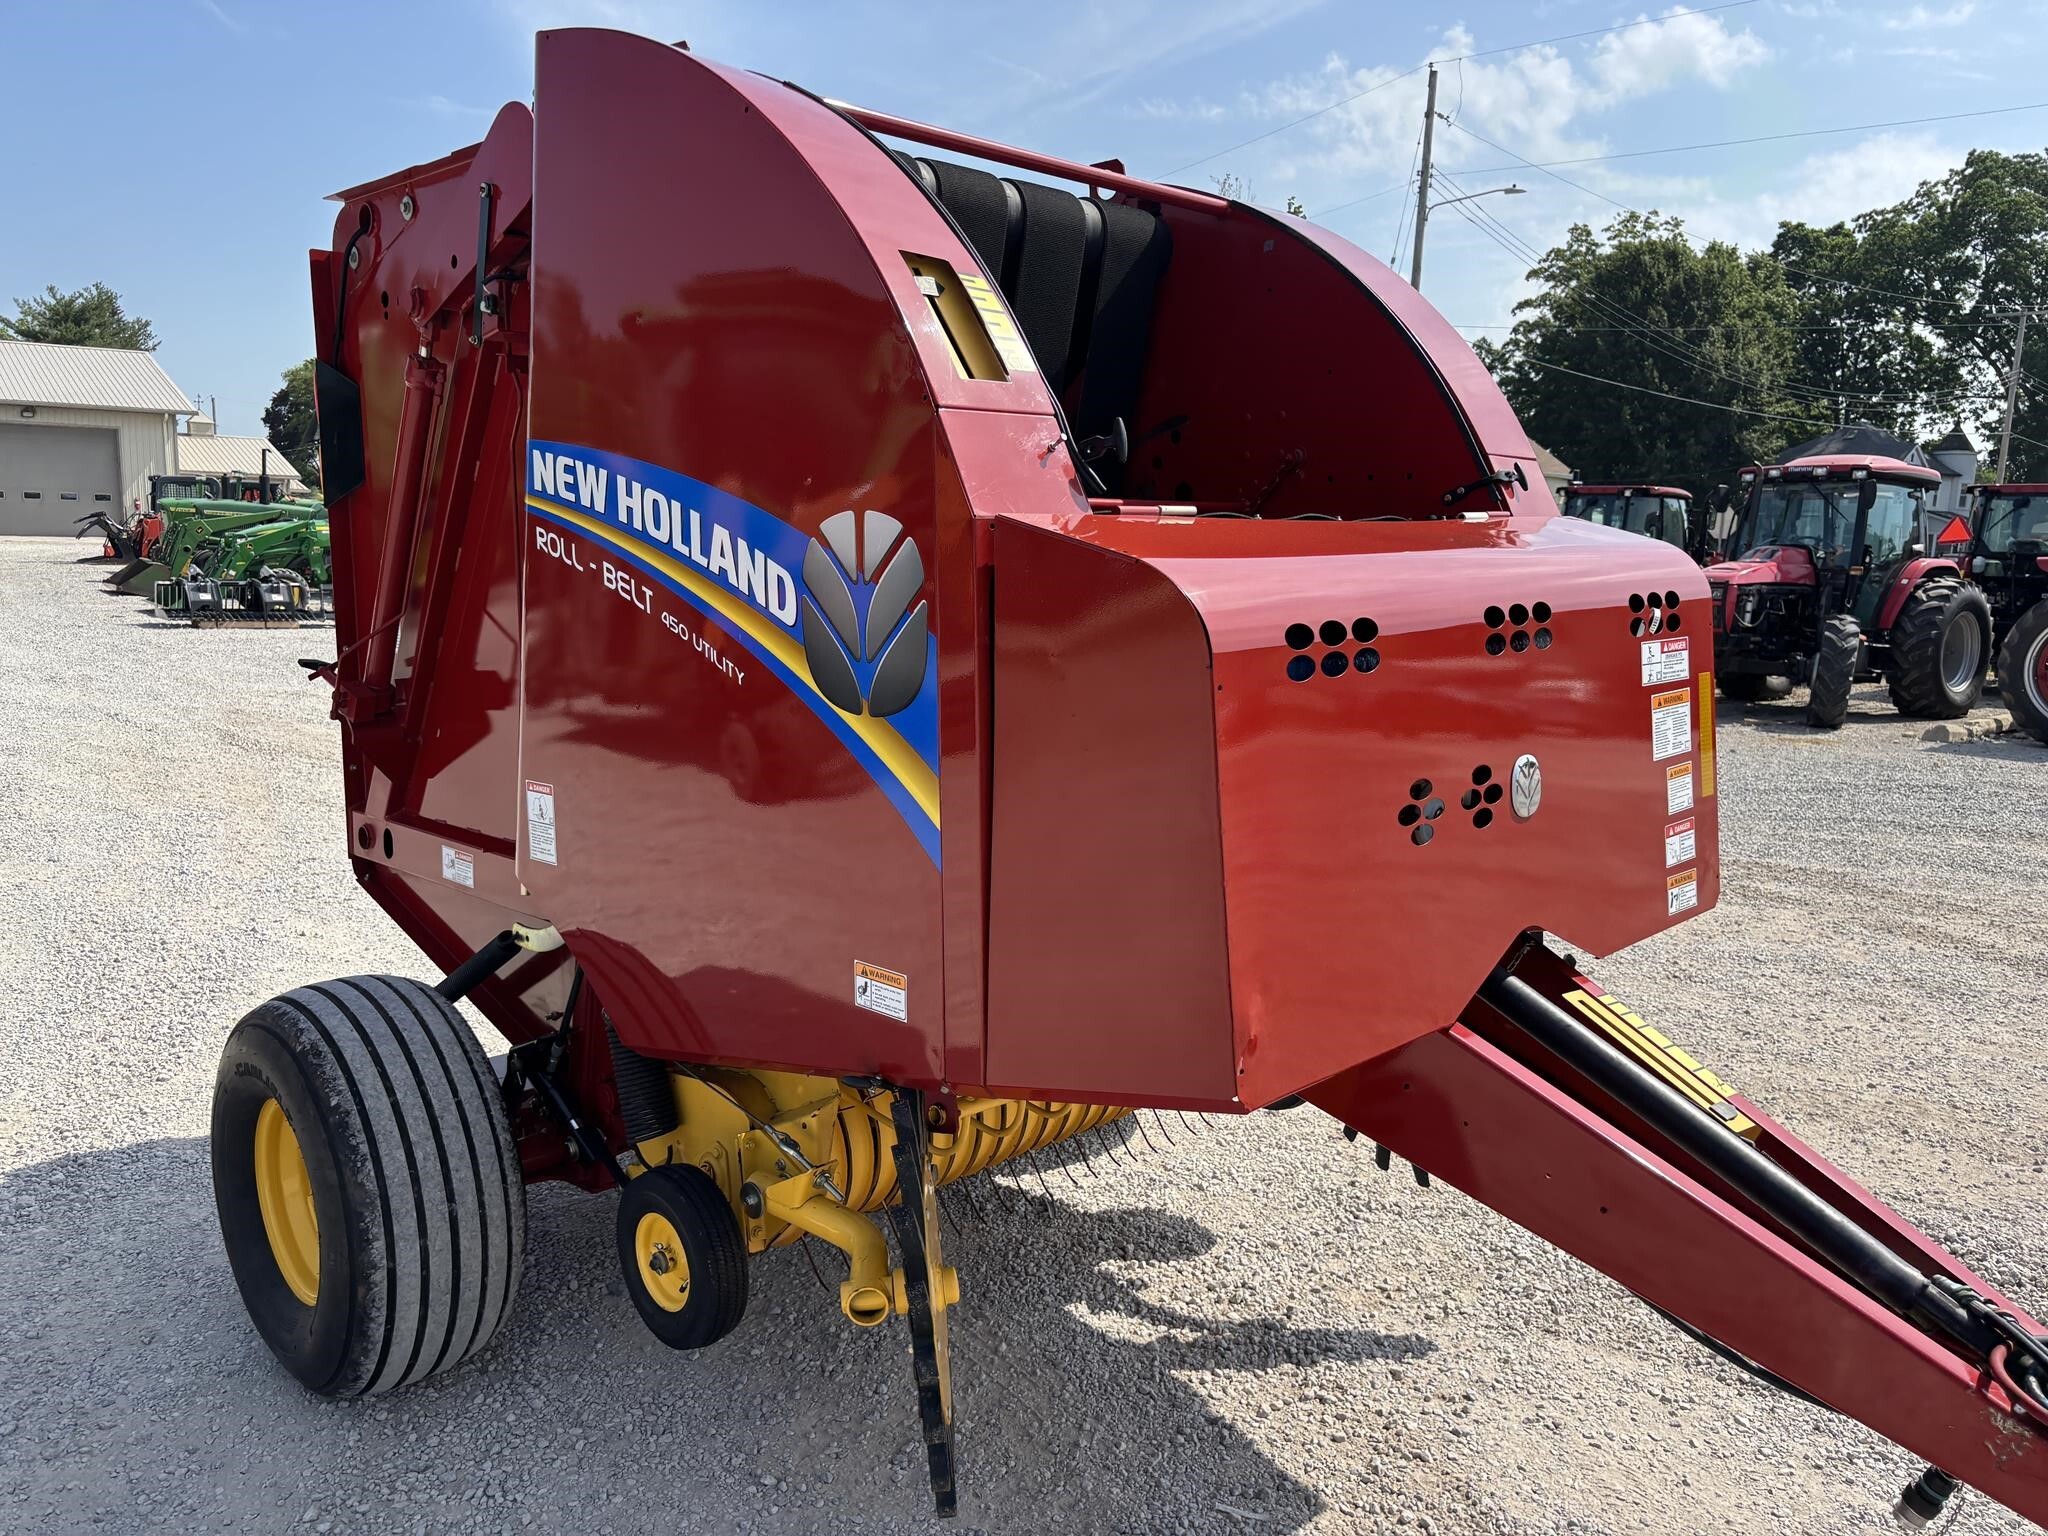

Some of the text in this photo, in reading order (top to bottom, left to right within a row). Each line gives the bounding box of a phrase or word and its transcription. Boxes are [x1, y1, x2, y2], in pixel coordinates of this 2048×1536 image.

[532, 449, 798, 627] NEW HOLLAND
[536, 526, 584, 572] ROLL
[603, 560, 653, 615] BELT
[661, 611, 689, 641] 450
[693, 633, 745, 686] UTILITY
[1668, 641, 1686, 651] DANGER
[1663, 694, 1683, 706] WARNING
[869, 968, 902, 986] WARNING
